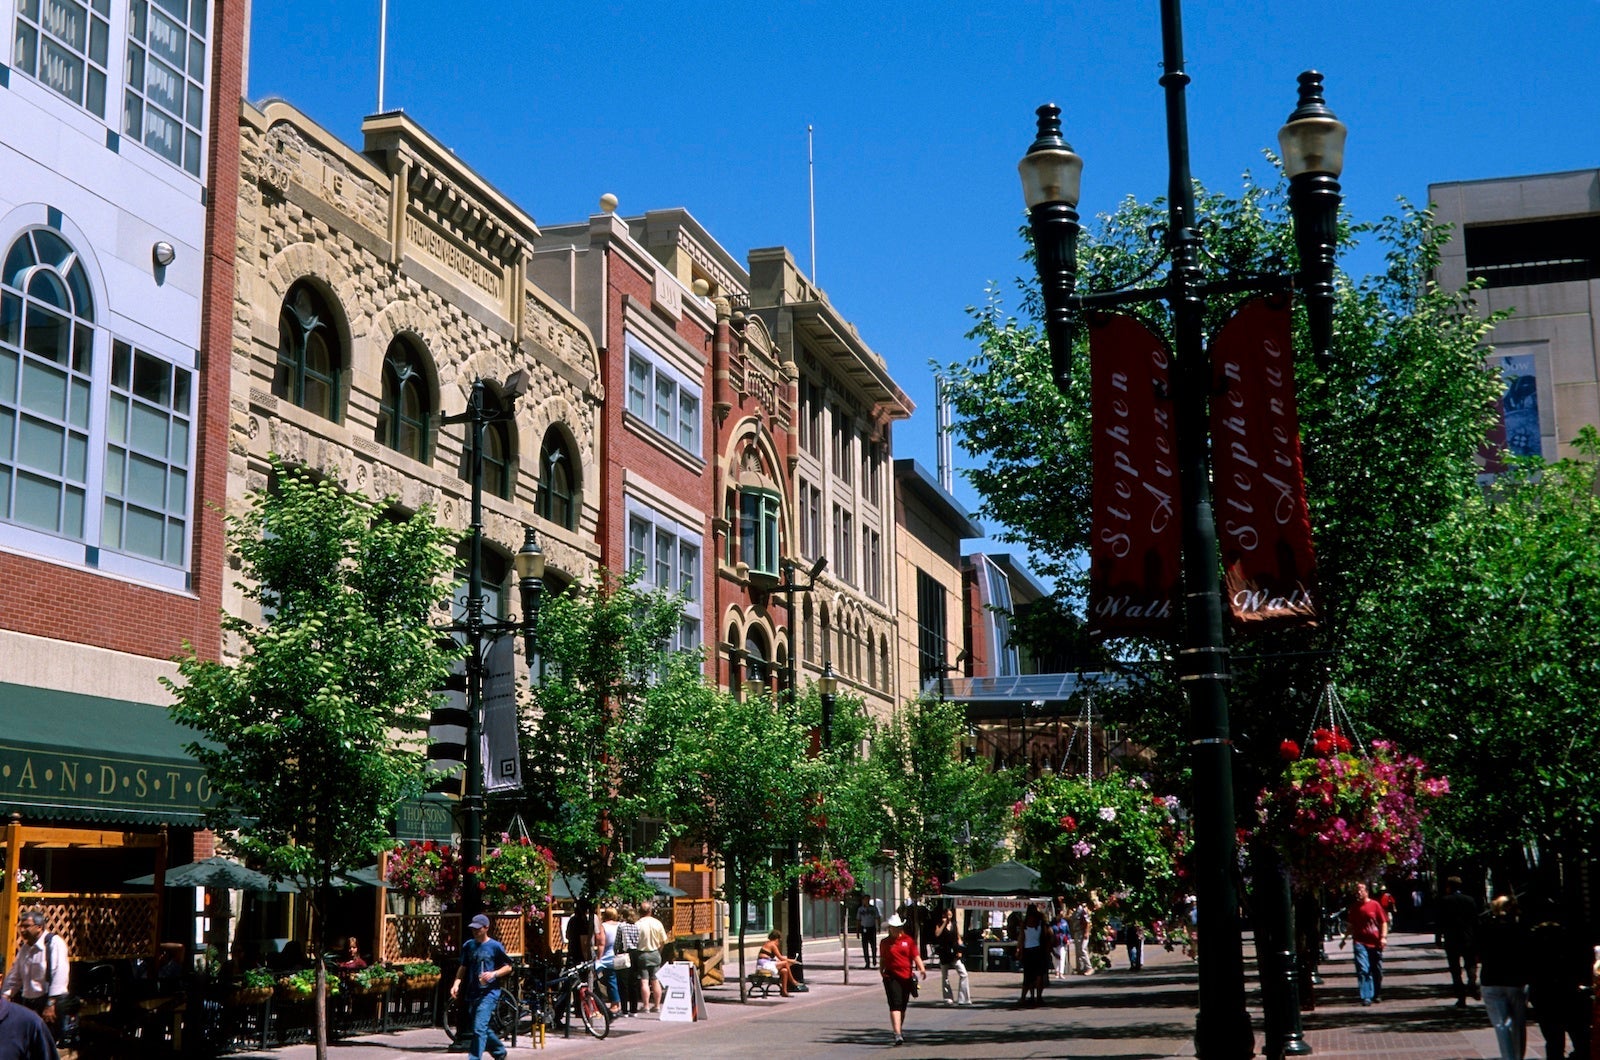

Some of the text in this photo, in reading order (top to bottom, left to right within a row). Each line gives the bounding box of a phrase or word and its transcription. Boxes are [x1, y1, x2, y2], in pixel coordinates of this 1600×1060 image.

[1101, 371, 1139, 558] Stephen
[1222, 360, 1259, 551] Stephen
[1262, 339, 1296, 525] Avenue
[1095, 595, 1173, 618] Walk
[1233, 588, 1313, 613] Walk
[957, 899, 994, 908] LEATHER
[997, 901, 1021, 909] BUSH
